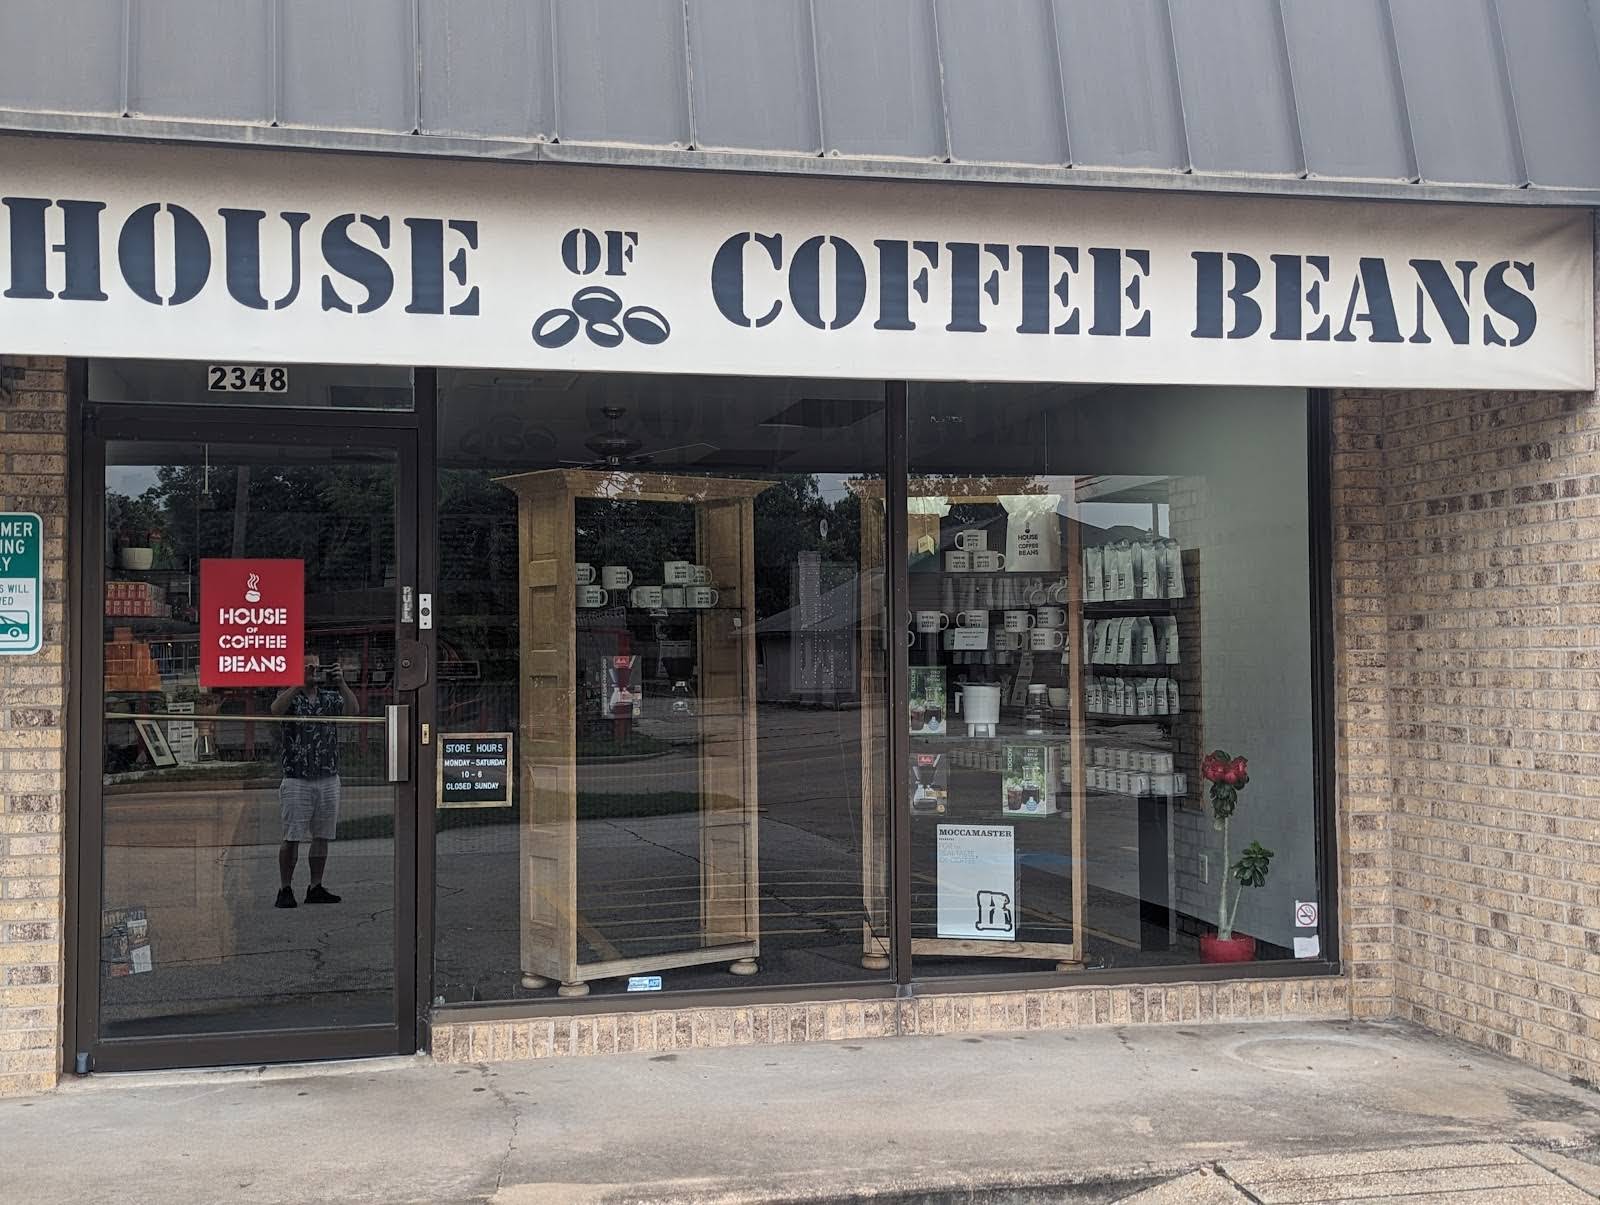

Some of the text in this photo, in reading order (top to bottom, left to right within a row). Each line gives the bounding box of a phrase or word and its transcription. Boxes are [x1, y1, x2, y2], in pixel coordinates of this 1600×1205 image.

[2, 197, 1537, 348] HOUSE OF COFFEE BEANS
[210, 367, 286, 391] 2348
[0, 556, 12, 571] Y
[7, 584, 30, 593] WILL
[219, 608, 287, 625] HOUSE
[246, 626, 259, 634] OF
[218, 635, 287, 649] COFFEE
[218, 655, 287, 673] BEANS
[445, 743, 504, 753] STORE HOURS
[445, 782, 499, 790] CLOSED SUNDAY
[938, 827, 1012, 838] MOCCAMASTER
